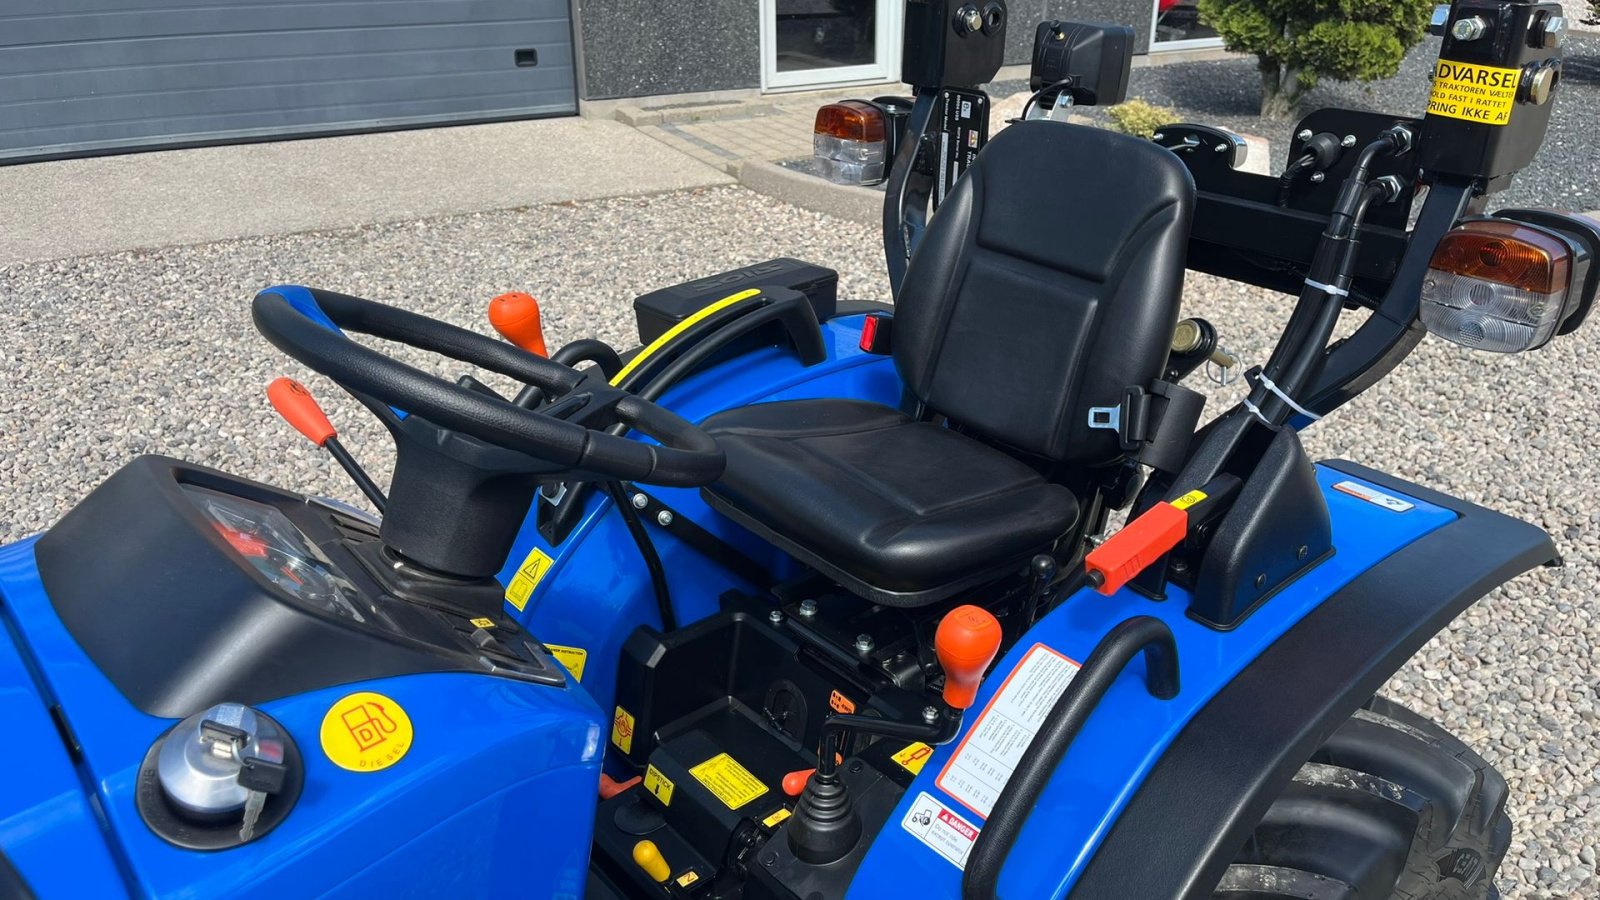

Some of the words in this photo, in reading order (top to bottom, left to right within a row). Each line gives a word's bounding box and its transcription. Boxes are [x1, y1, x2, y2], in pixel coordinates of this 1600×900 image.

[1435, 63, 1516, 89] DVARSEL
[1439, 81, 1486, 95] TRAKTOREN
[1448, 93, 1467, 103] FAST
[1476, 98, 1507, 109] RATTET
[1462, 106, 1491, 120] IKKE
[359, 742, 405, 767] DIESEL
[649, 768, 671, 790] DIPSTICK
[948, 817, 975, 838] DANGER
